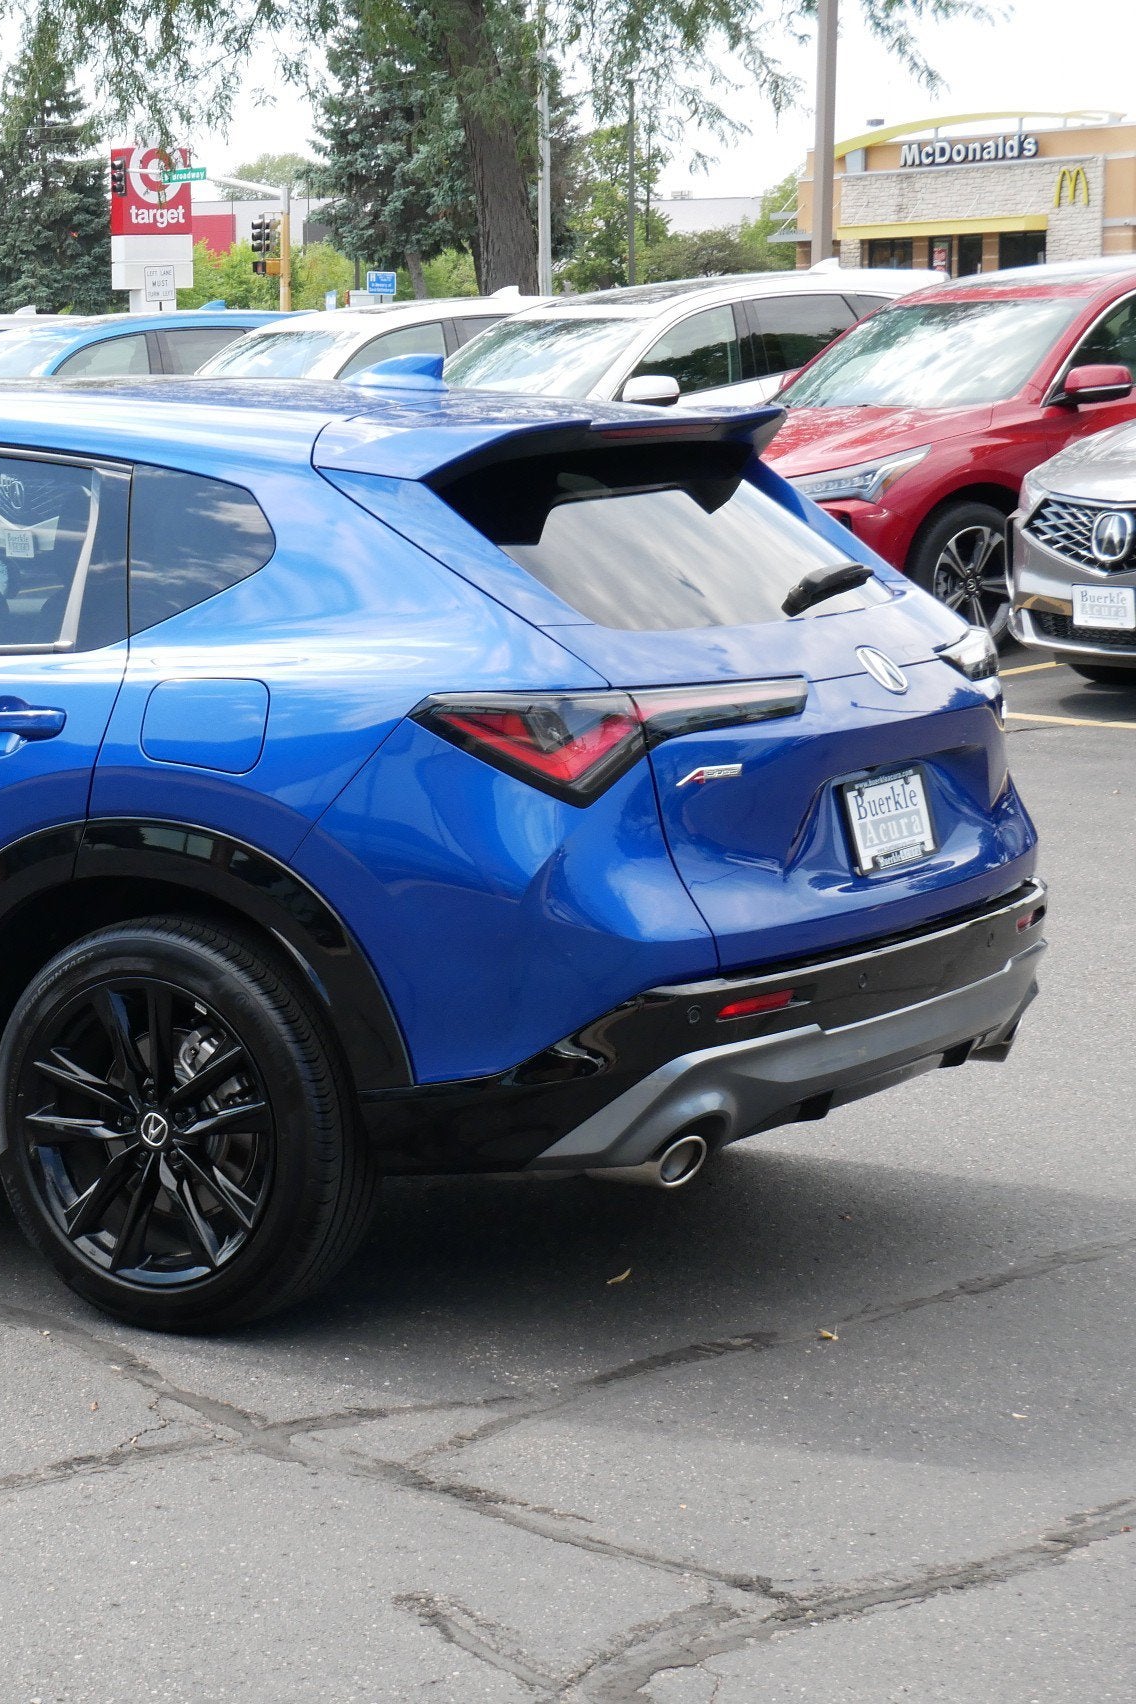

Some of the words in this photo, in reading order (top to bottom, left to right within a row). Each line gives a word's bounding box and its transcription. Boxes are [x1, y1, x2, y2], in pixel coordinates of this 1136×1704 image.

[900, 134, 1039, 167] McDonald's
[130, 205, 185, 228] target
[1080, 590, 1127, 605] Buerkle
[853, 783, 919, 821] Buerkle
[865, 814, 923, 847] Acura
